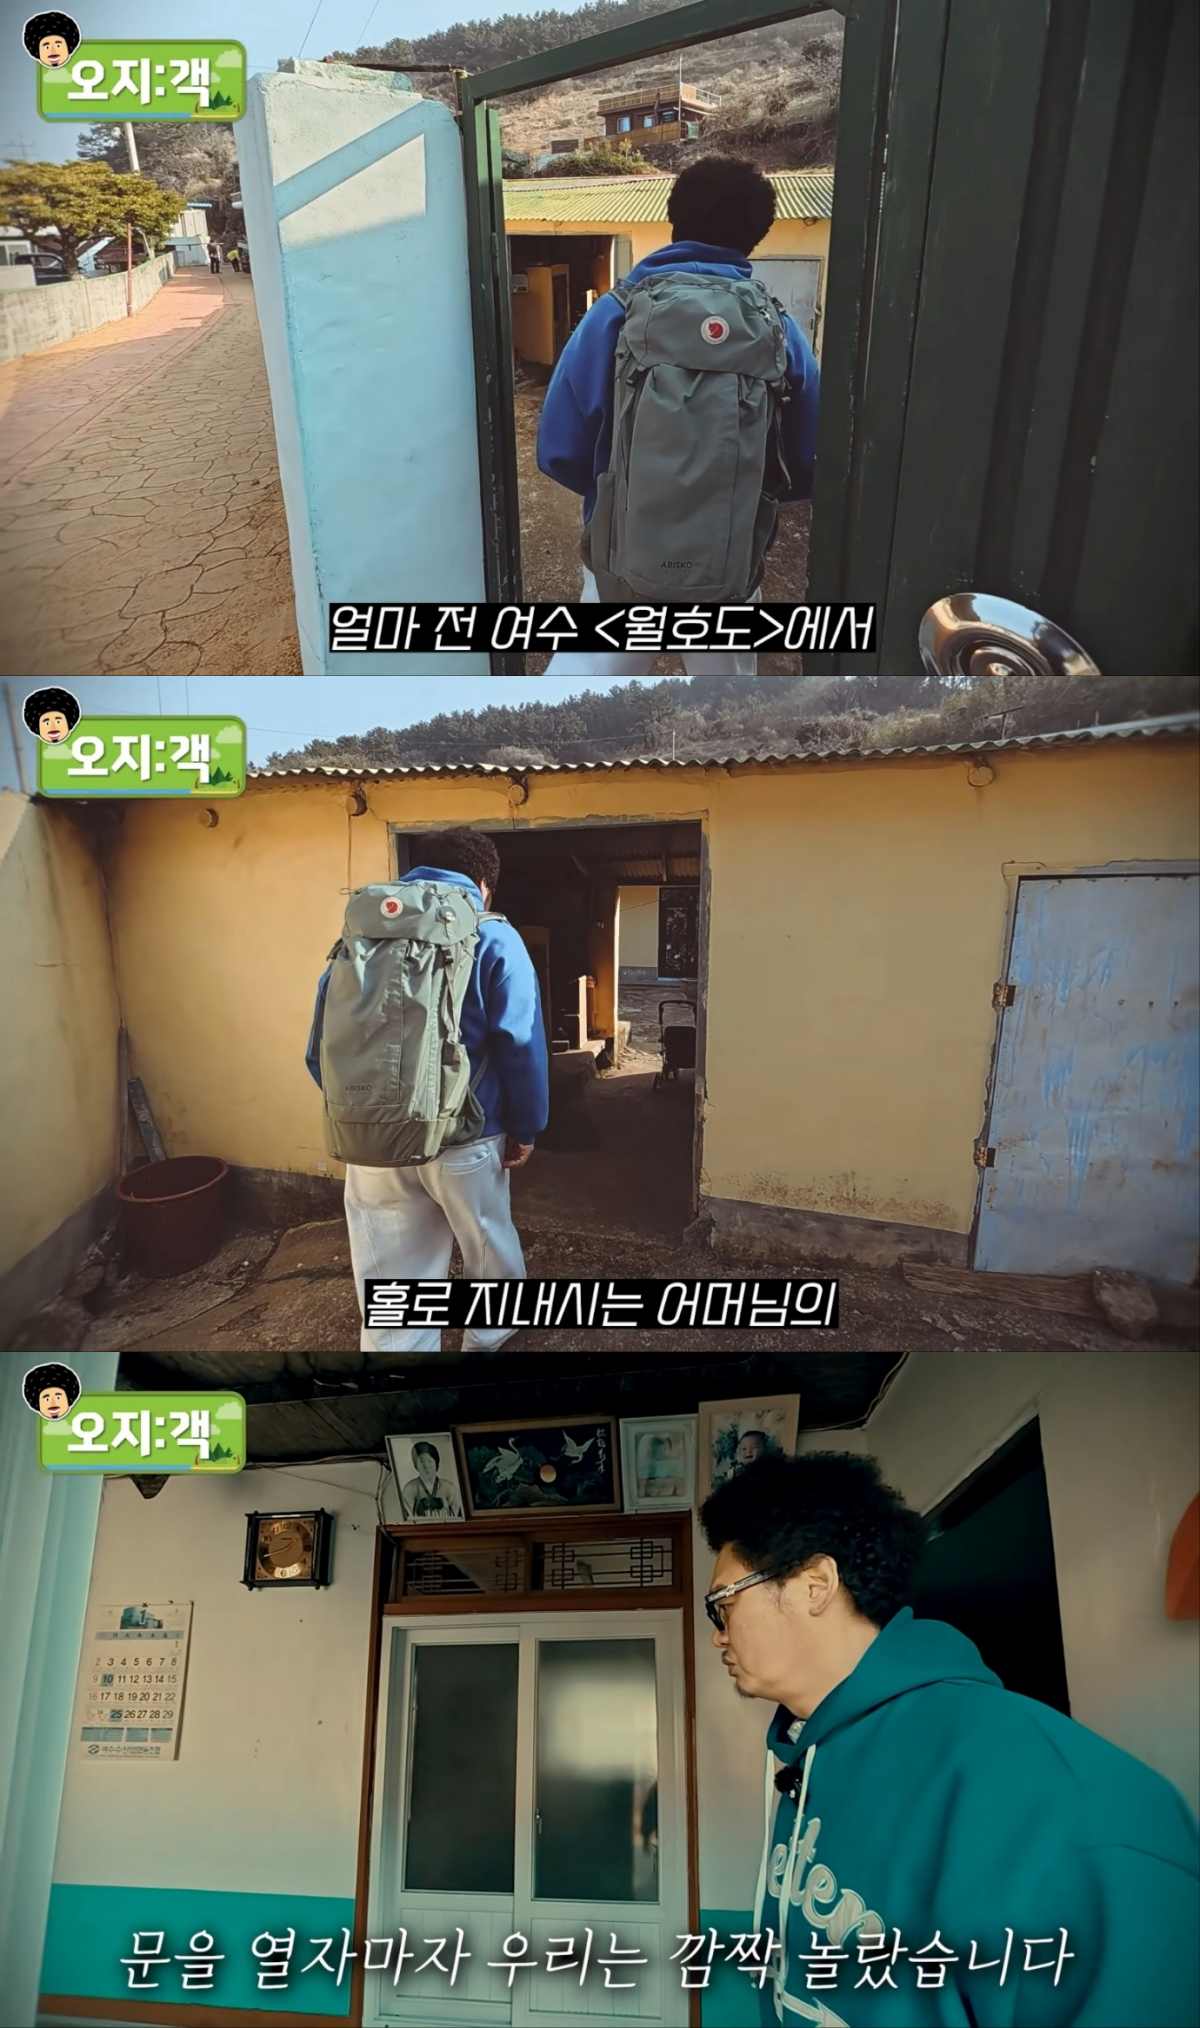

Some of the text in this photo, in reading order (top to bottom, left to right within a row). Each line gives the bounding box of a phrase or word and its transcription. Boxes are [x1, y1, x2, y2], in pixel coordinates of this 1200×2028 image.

[106, 1657, 114, 1666] 3
[120, 1657, 127, 1666] 4
[133, 1657, 140, 1666] 5
[146, 1657, 152, 1666] 6
[159, 1657, 165, 1666] 7
[103, 1674, 113, 1684] 10
[118, 1674, 126, 1684] 11
[130, 1674, 139, 1684] 12
[143, 1674, 152, 1684] 13
[155, 1674, 164, 1684] 14
[167, 1674, 177, 1684] 15
[101, 1692, 111, 1701] 17
[114, 1692, 124, 1701] 18
[128, 1692, 138, 1701] 19
[140, 1692, 150, 1701] 20
[152, 1692, 162, 1701] 21
[164, 1692, 176, 1701] 22
[111, 1709, 122, 1719] 25
[124, 1709, 136, 1719] 26
[136, 1709, 148, 1719] 27
[149, 1709, 160, 1719] 28
[162, 1709, 174, 1719] 29
